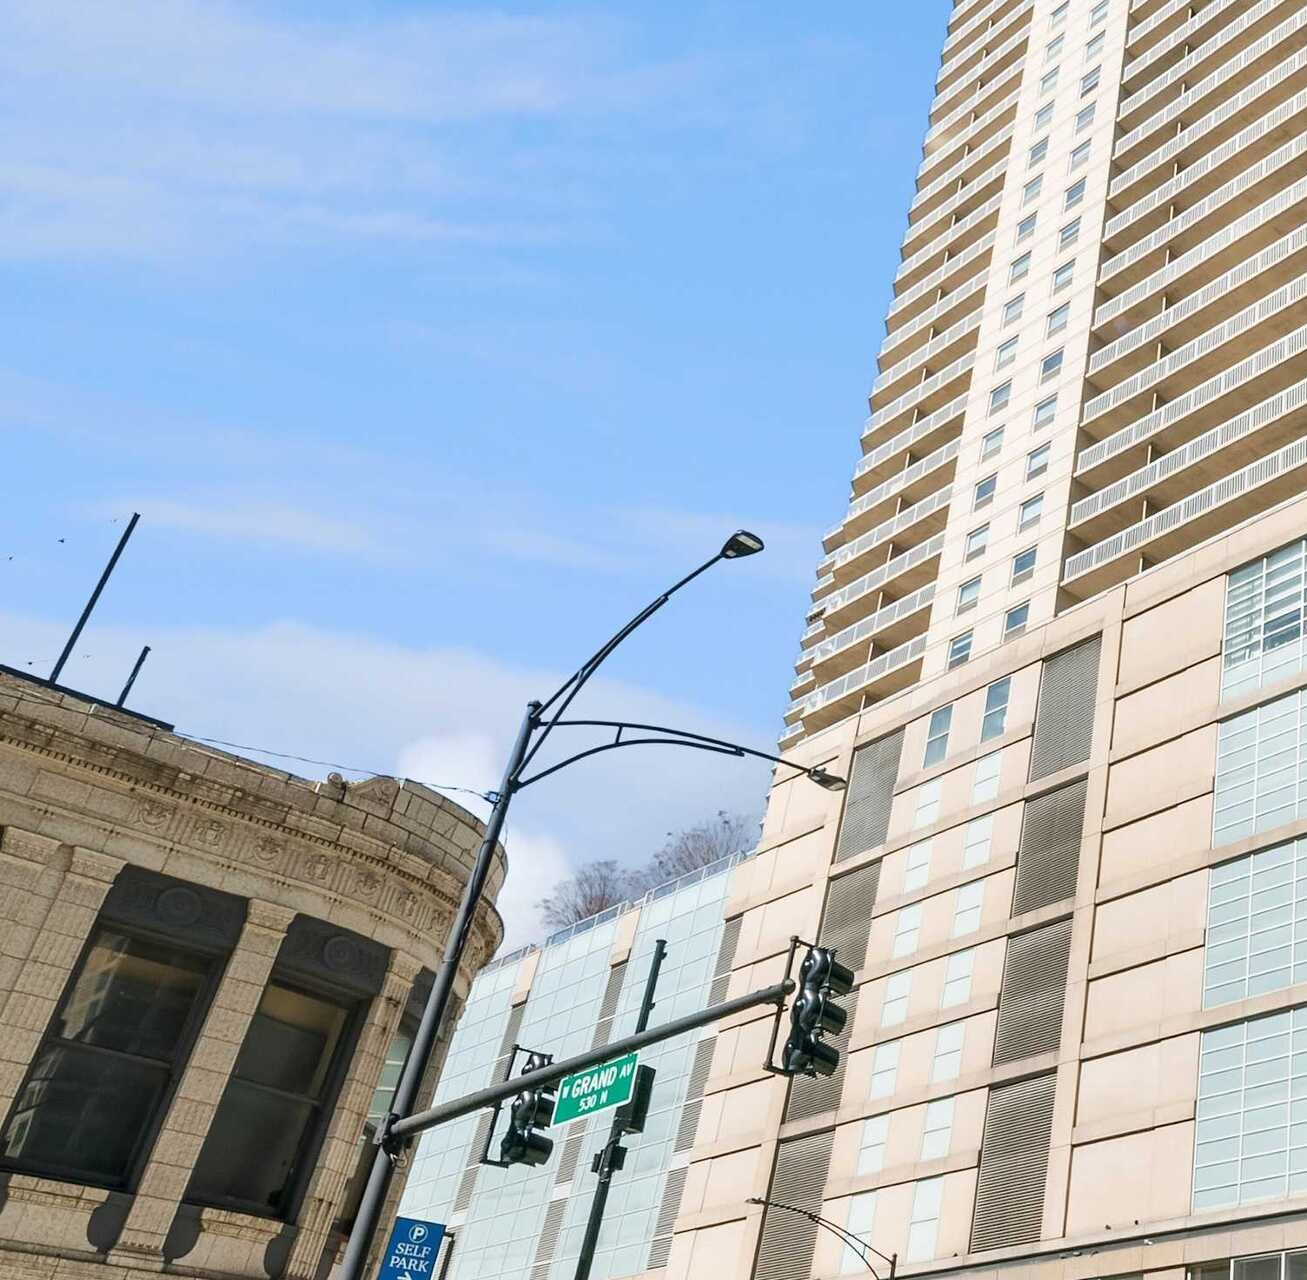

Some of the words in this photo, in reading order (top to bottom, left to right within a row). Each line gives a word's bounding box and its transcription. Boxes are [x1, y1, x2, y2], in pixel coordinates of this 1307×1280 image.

[562, 1085, 570, 1099] W
[571, 1066, 617, 1099] GRAND
[619, 1062, 633, 1079] AV
[578, 1094, 597, 1112] 530
[600, 1089, 608, 1105] N
[395, 1242, 432, 1258] SELF
[389, 1256, 430, 1273] PARK
